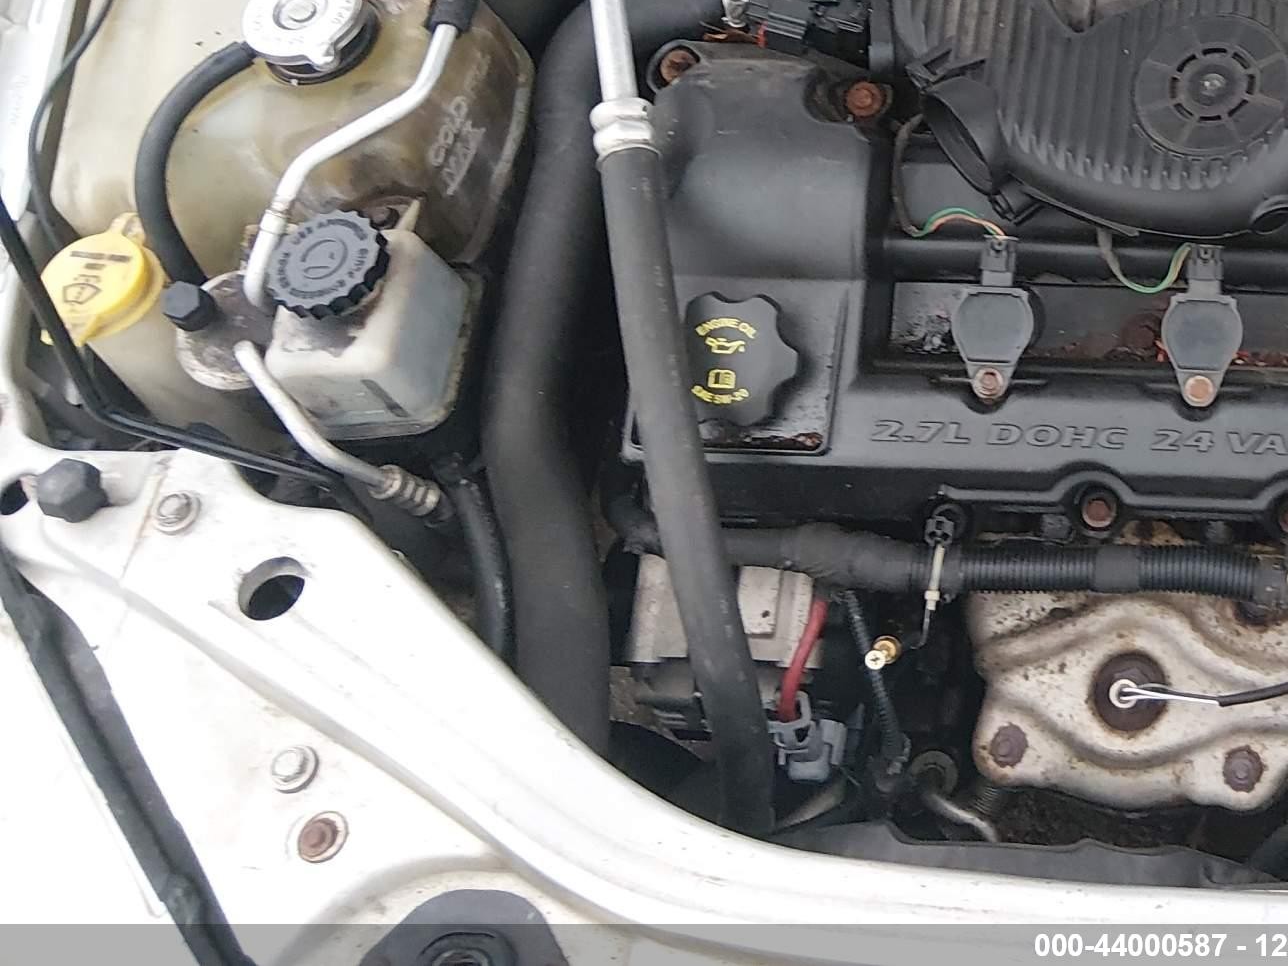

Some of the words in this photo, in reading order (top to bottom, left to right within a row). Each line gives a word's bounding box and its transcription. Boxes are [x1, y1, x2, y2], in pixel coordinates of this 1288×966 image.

[695, 317, 741, 337] ENGINE
[738, 321, 757, 339] OIL
[870, 419, 971, 445] 2.7L
[985, 423, 1130, 450] DOHC
[1150, 428, 1214, 453] 24
